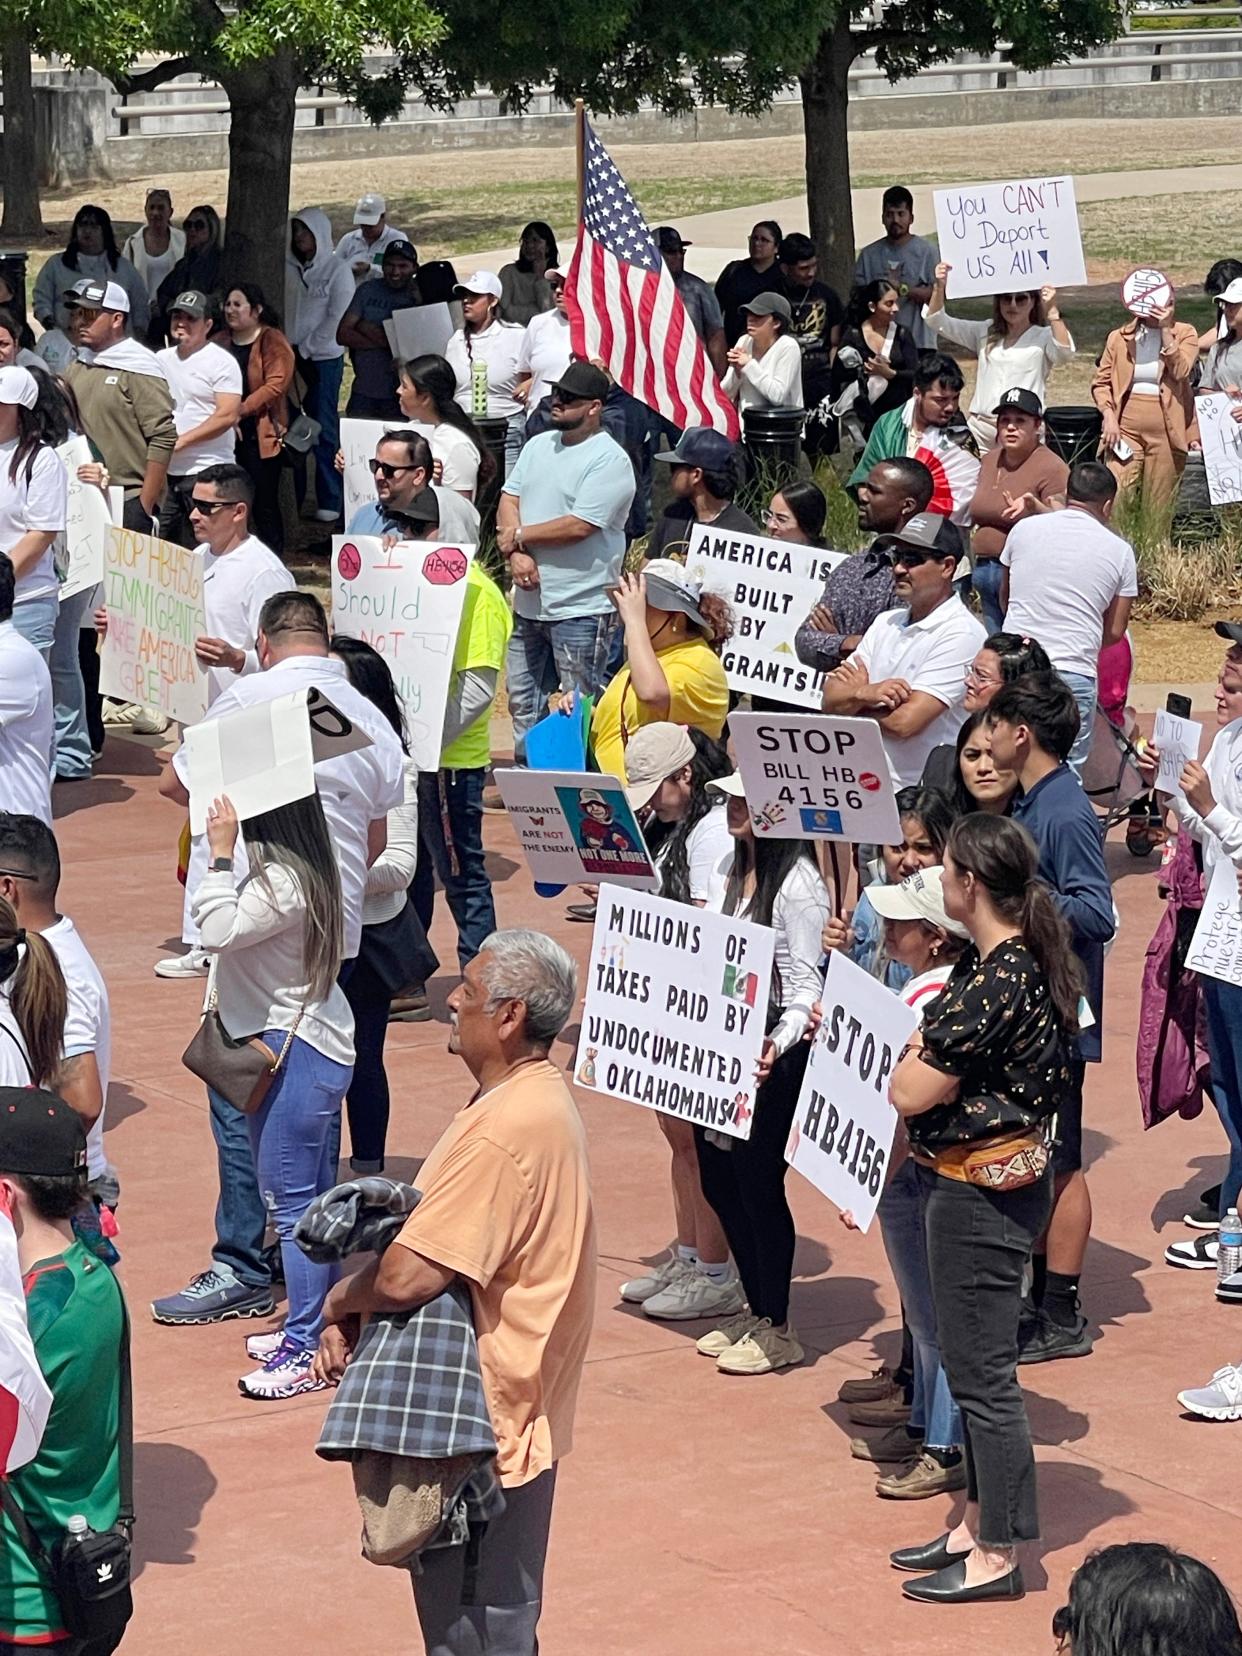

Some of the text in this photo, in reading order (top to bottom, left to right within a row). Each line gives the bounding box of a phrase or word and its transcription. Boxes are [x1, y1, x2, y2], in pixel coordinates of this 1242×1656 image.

[106, 527, 144, 568] STOP
[696, 534, 832, 583] AMERICA IS
[337, 582, 421, 620] Should
[734, 582, 794, 615] BUILT
[739, 615, 767, 641] BY
[137, 626, 196, 684] AMERICA
[756, 725, 856, 756] STOP
[1170, 719, 1183, 742] TO
[763, 762, 856, 783] BILL HB
[778, 785, 863, 810] 4156
[522, 830, 565, 840] ARE NOT
[522, 843, 574, 854] THE ENEMY
[608, 903, 748, 965] MILLIONS OF
[596, 963, 750, 1036] TAXES PAID BY
[588, 1015, 742, 1086] UNDOCUMENTED
[825, 1003, 893, 1093] STOP
[802, 1087, 886, 1198] HB4156
